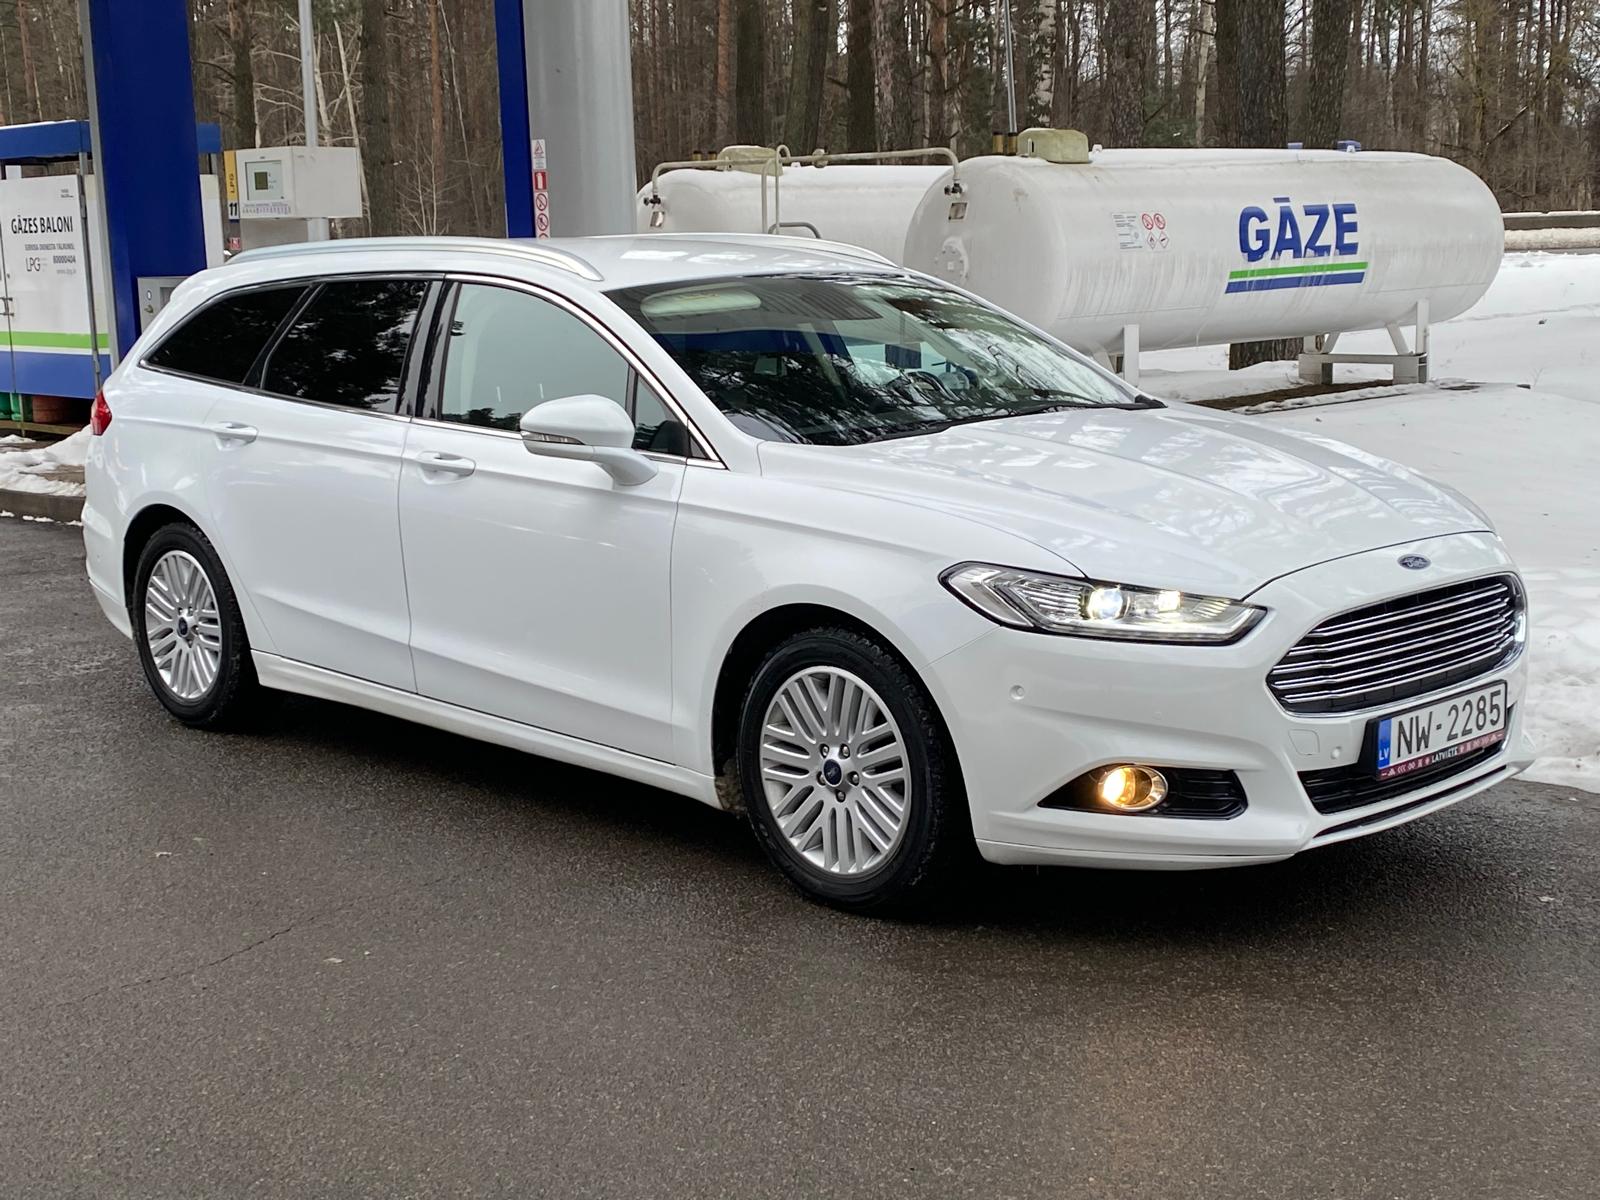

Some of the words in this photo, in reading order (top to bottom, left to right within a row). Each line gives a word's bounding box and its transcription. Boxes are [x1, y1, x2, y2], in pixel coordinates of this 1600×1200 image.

[229, 202, 238, 217] 11
[11, 214, 38, 234] GĀZES
[40, 216, 73, 233] BALONI
[1239, 197, 1359, 262] GĀZE
[25, 256, 41, 272] LPG
[1378, 747, 1390, 761] LV
